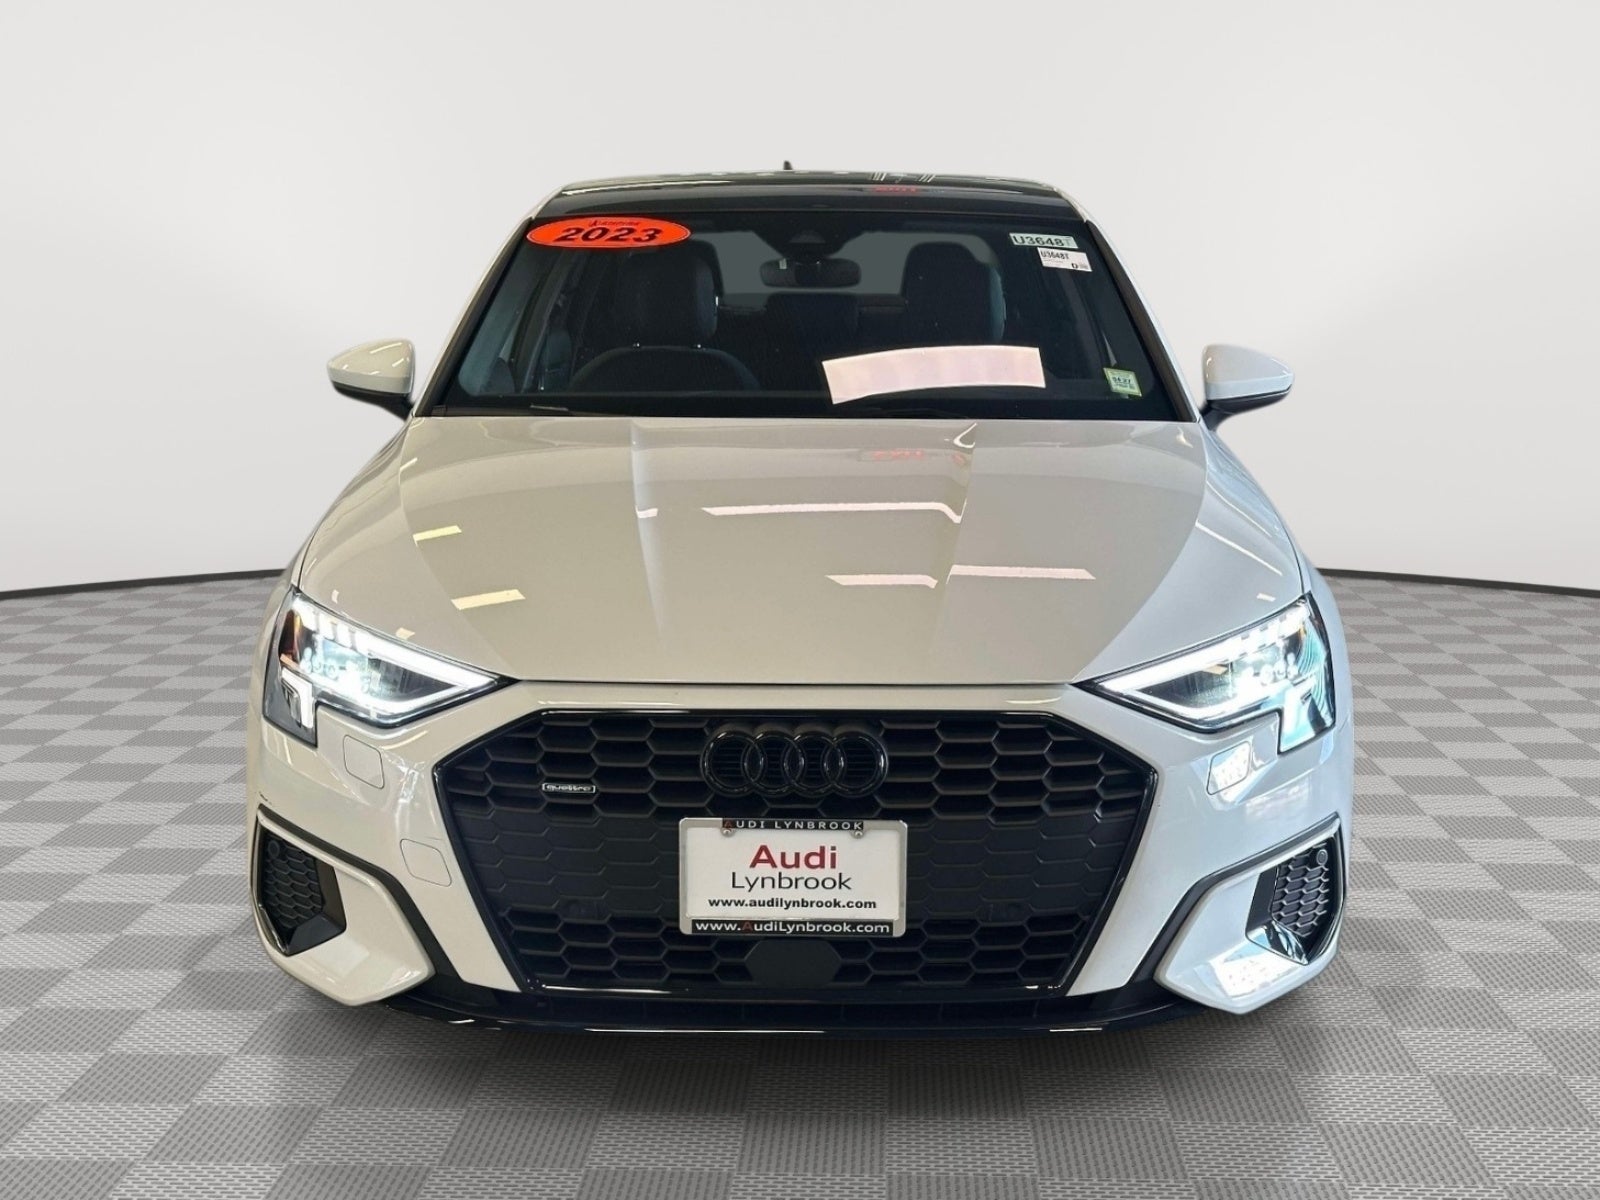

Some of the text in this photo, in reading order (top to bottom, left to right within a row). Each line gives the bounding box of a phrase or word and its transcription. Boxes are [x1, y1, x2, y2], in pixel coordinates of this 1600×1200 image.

[553, 227, 663, 243] 2023
[724, 820, 863, 830] AUDI LYNBROOK
[749, 845, 837, 869] Audi
[732, 871, 852, 892] Lynbrook
[708, 898, 877, 910] www.audilynbrook.com
[695, 920, 890, 934] www.AudiLynbrook.com
